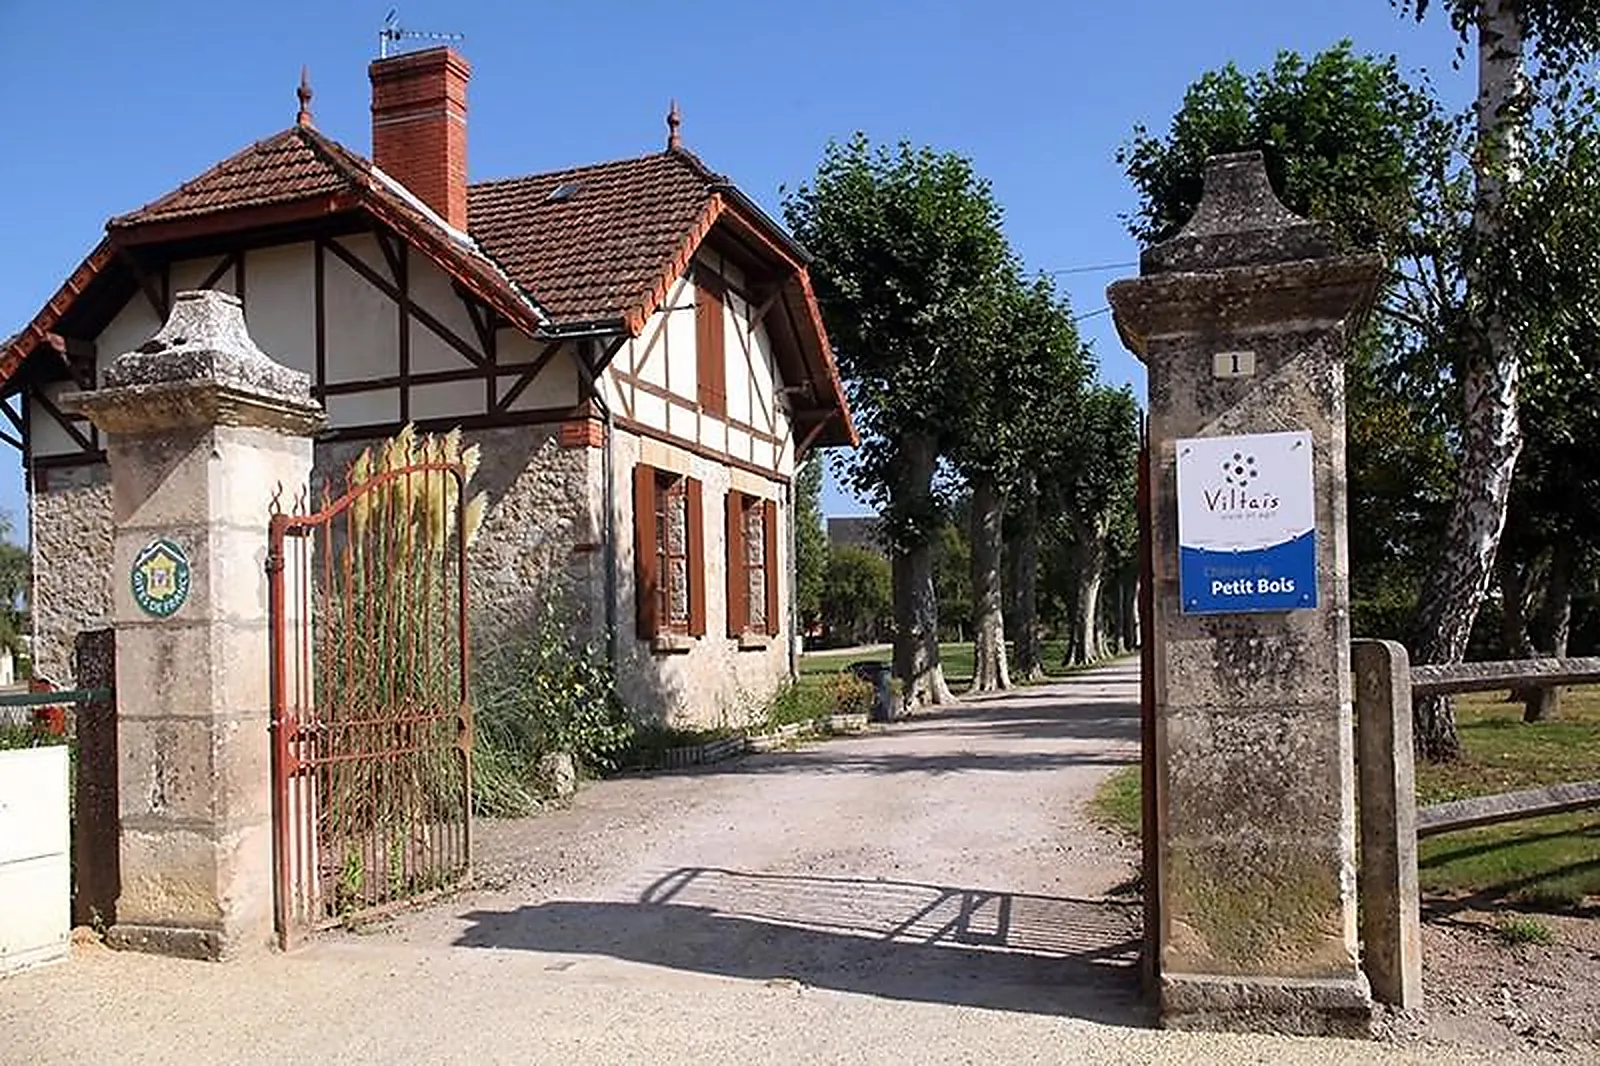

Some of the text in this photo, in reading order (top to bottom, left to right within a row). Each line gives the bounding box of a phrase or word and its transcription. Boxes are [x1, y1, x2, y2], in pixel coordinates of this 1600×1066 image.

[1231, 355, 1239, 373] 1
[1211, 577, 1295, 595] Petit Bois
